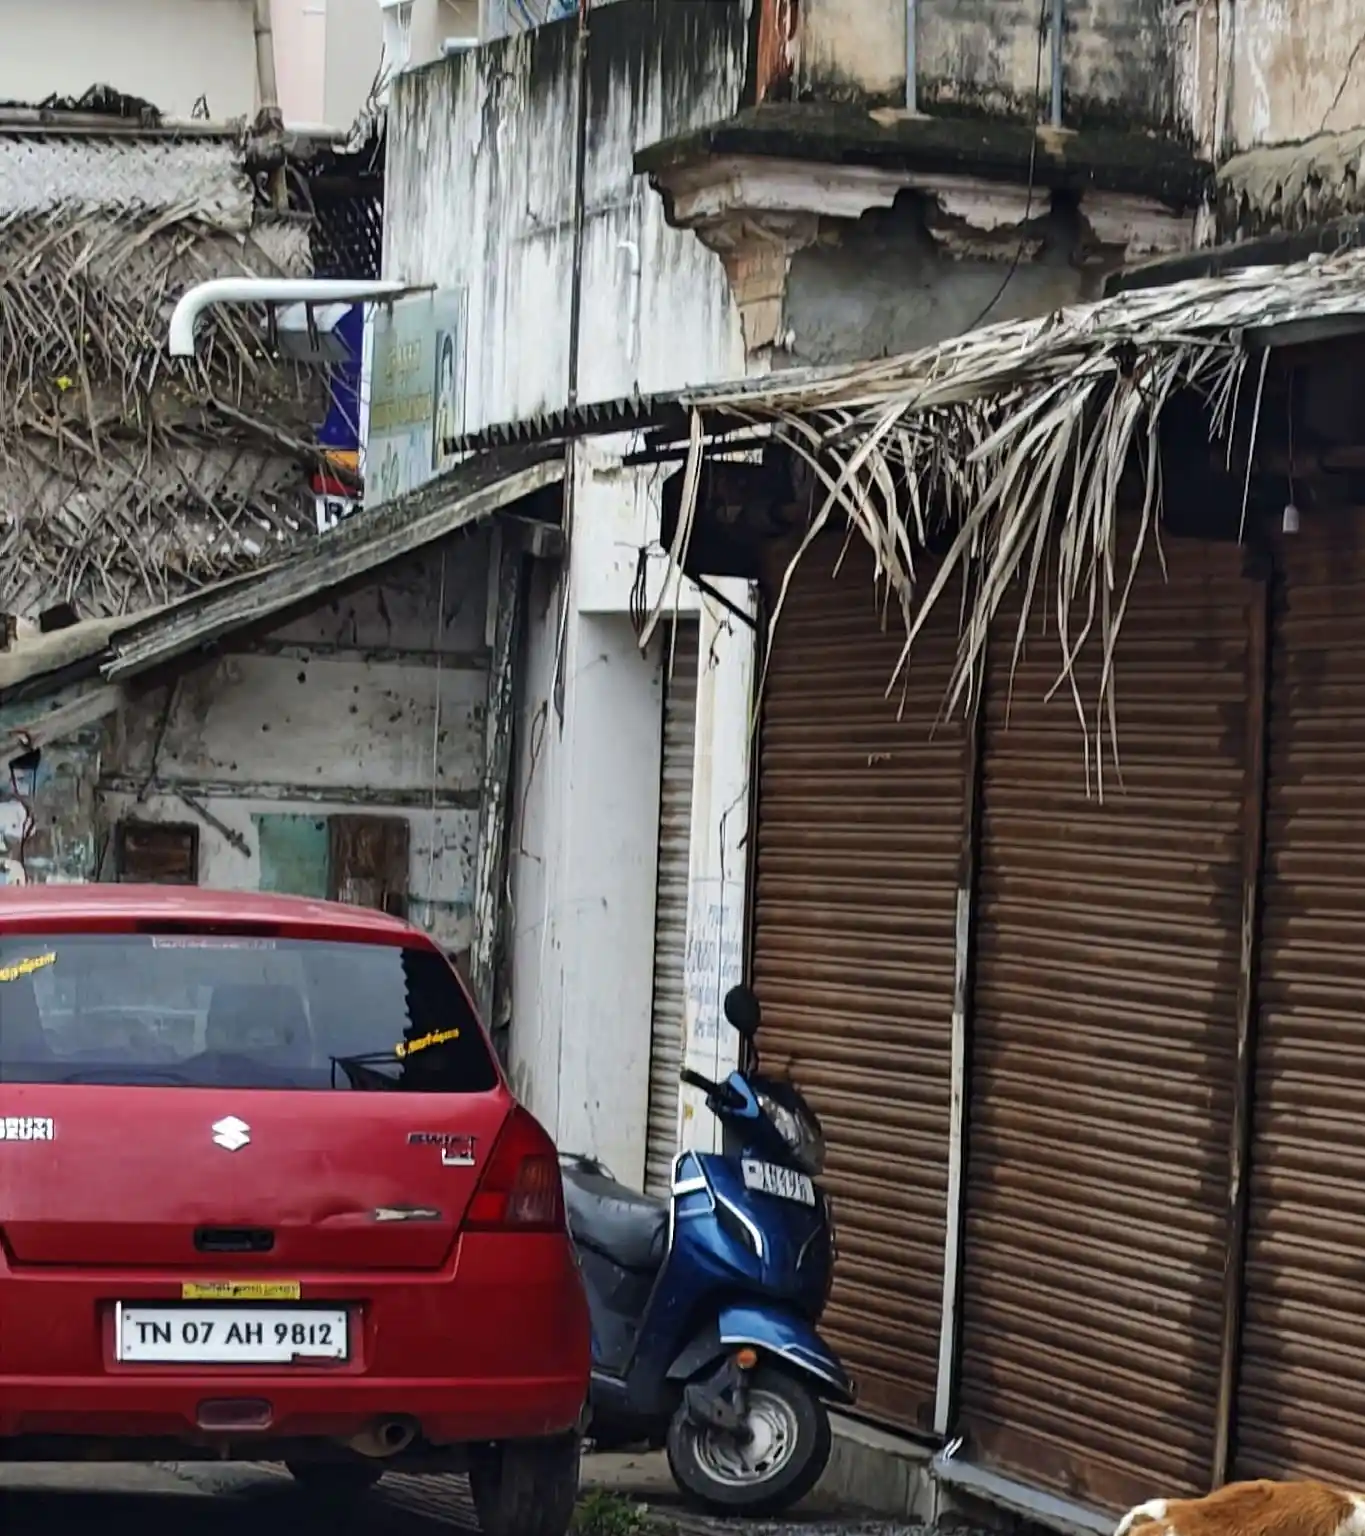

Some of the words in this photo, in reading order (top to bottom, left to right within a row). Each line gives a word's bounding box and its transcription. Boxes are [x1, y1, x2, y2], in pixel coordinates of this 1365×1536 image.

[136, 1322, 171, 1344] TN
[182, 1322, 214, 1344] 07
[224, 1322, 263, 1344] AH
[274, 1323, 332, 1345] 9812
